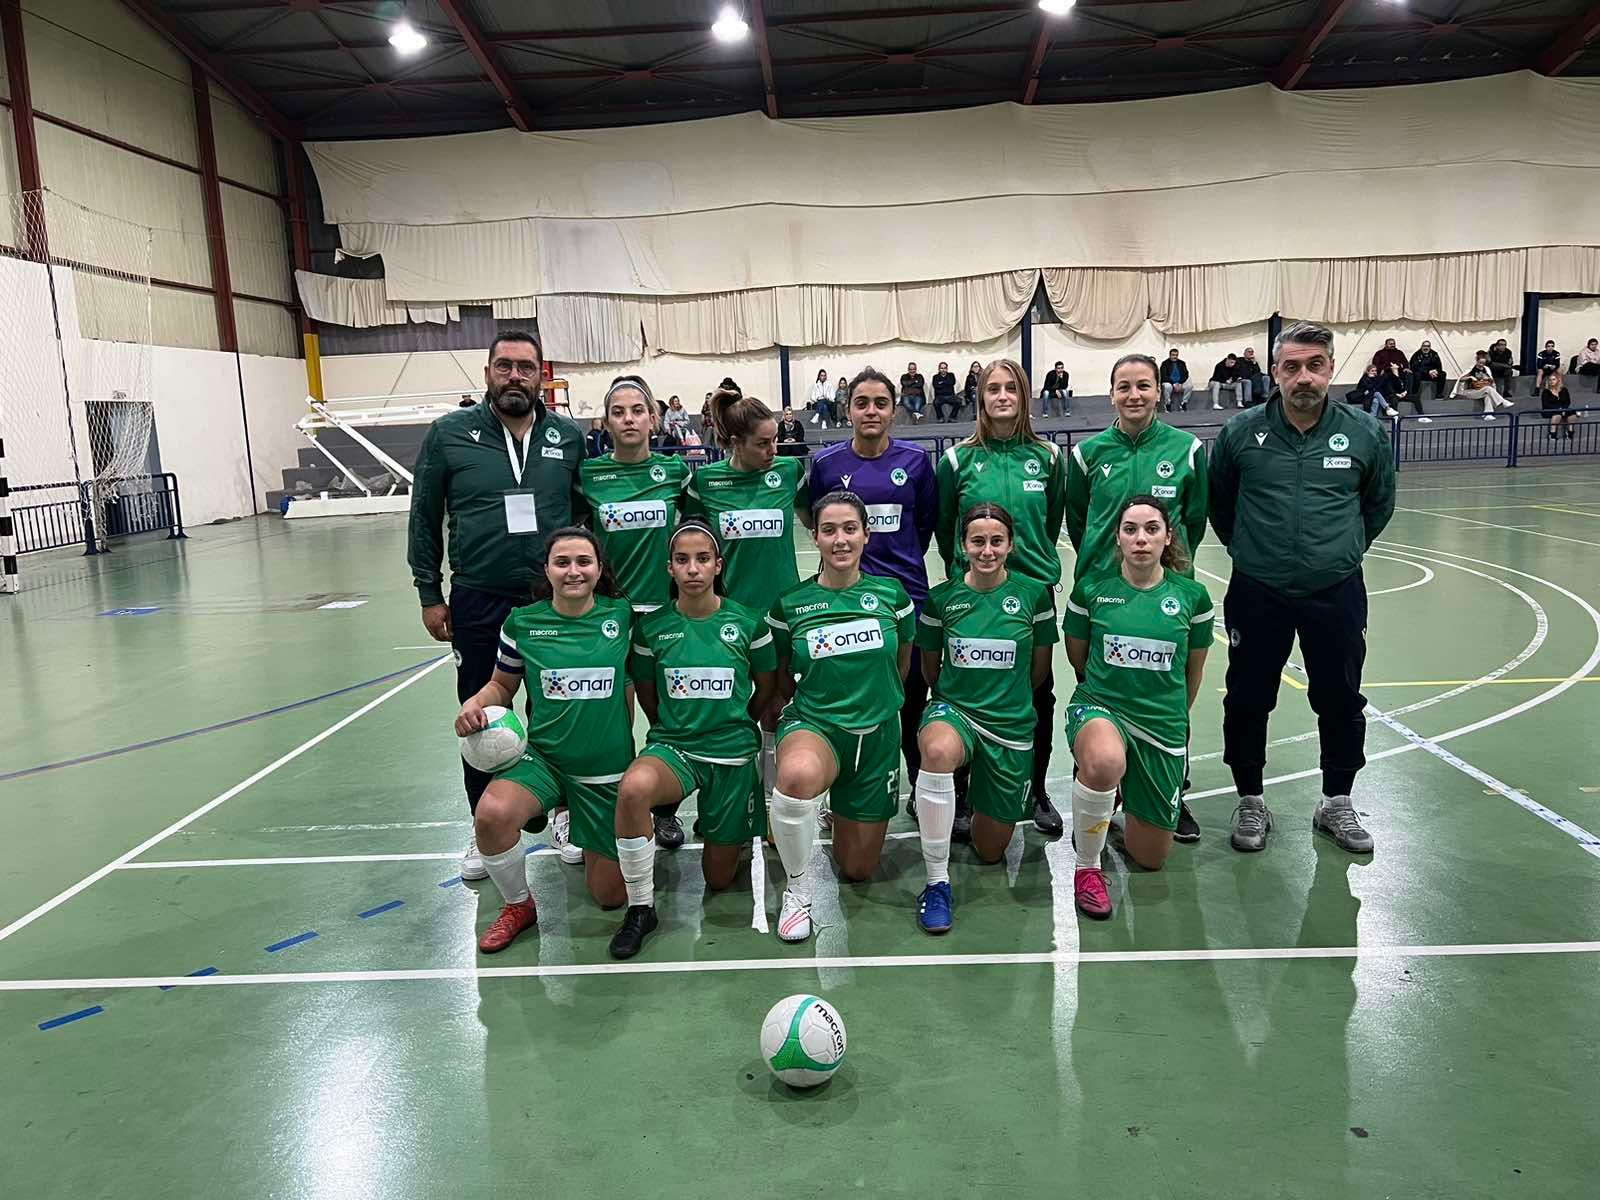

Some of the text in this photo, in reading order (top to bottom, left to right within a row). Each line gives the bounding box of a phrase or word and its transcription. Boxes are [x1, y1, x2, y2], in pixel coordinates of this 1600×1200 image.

[1097, 595, 1125, 604] macron
[795, 602, 829, 615] macron
[945, 602, 971, 611] macron
[658, 633, 684, 641] macron
[748, 791, 754, 813] 6
[1171, 787, 1179, 808] 4
[814, 1003, 845, 1055] macron
